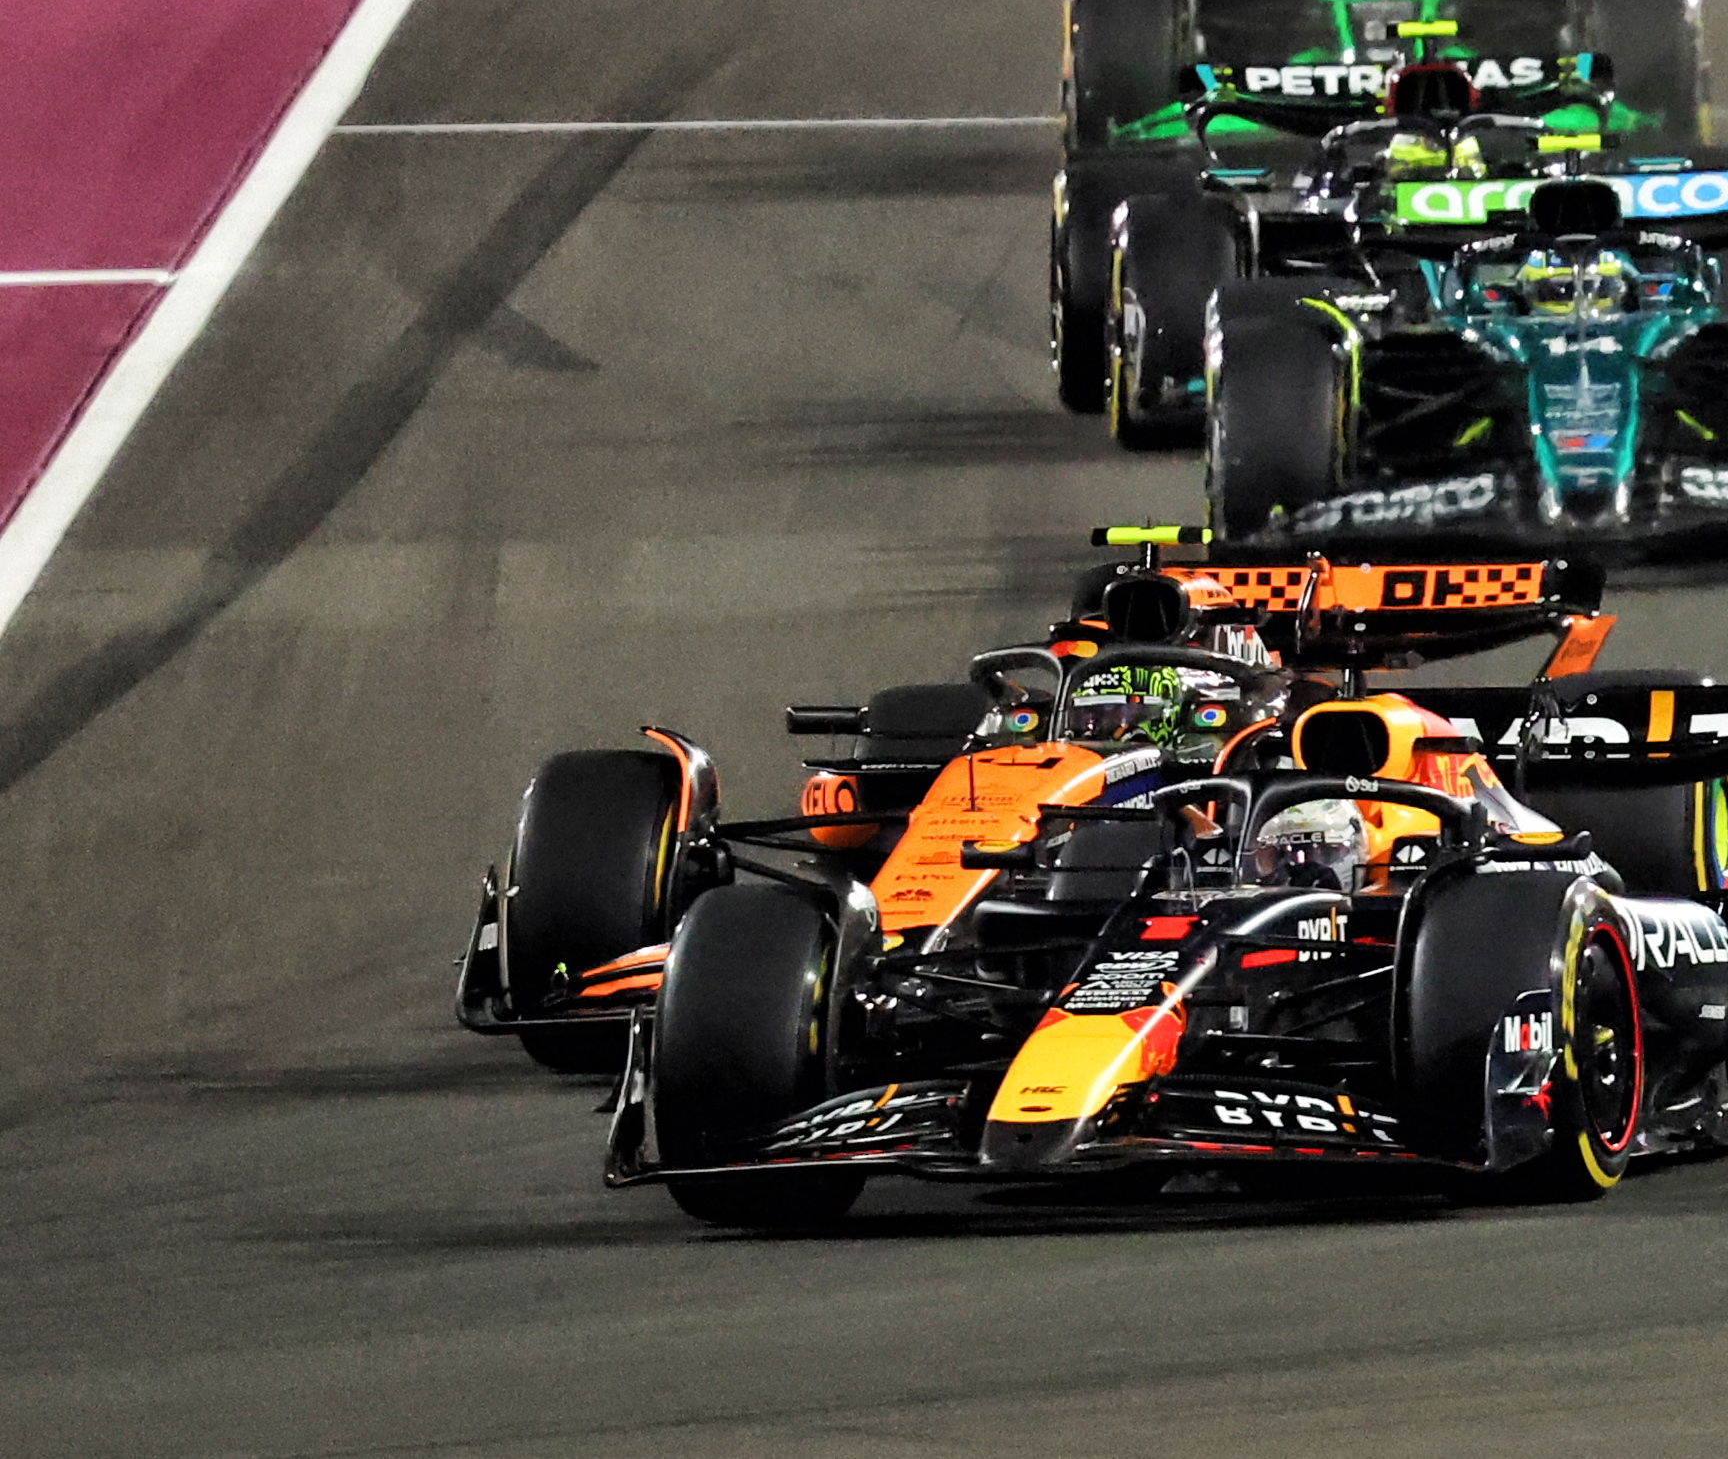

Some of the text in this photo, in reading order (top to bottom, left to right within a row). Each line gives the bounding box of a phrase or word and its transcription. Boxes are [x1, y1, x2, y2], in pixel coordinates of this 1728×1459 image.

[1108, 950, 1180, 961] VISA
[1087, 972, 1166, 981] zoom
[1504, 1012, 1553, 1054] Mobil
